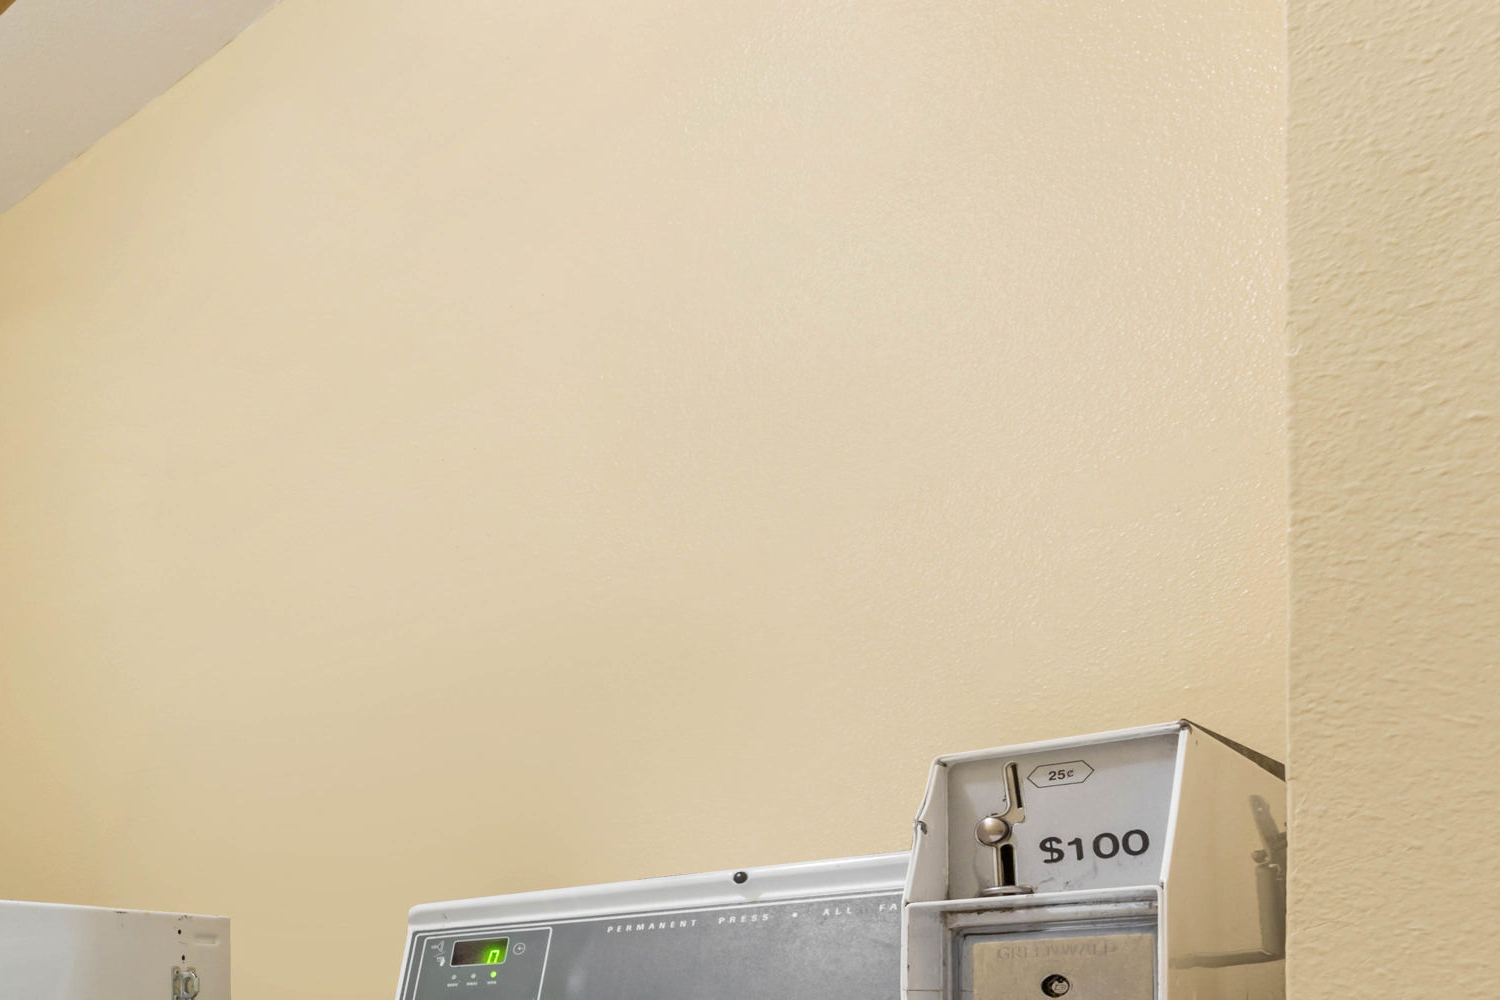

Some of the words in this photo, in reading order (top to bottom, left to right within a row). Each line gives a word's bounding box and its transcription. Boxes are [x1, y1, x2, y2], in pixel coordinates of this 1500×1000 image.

[1039, 829, 1150, 864] $100
[606, 919, 698, 934] PERMANENT
[718, 913, 770, 925] PRESS
[822, 906, 853, 916] ALL
